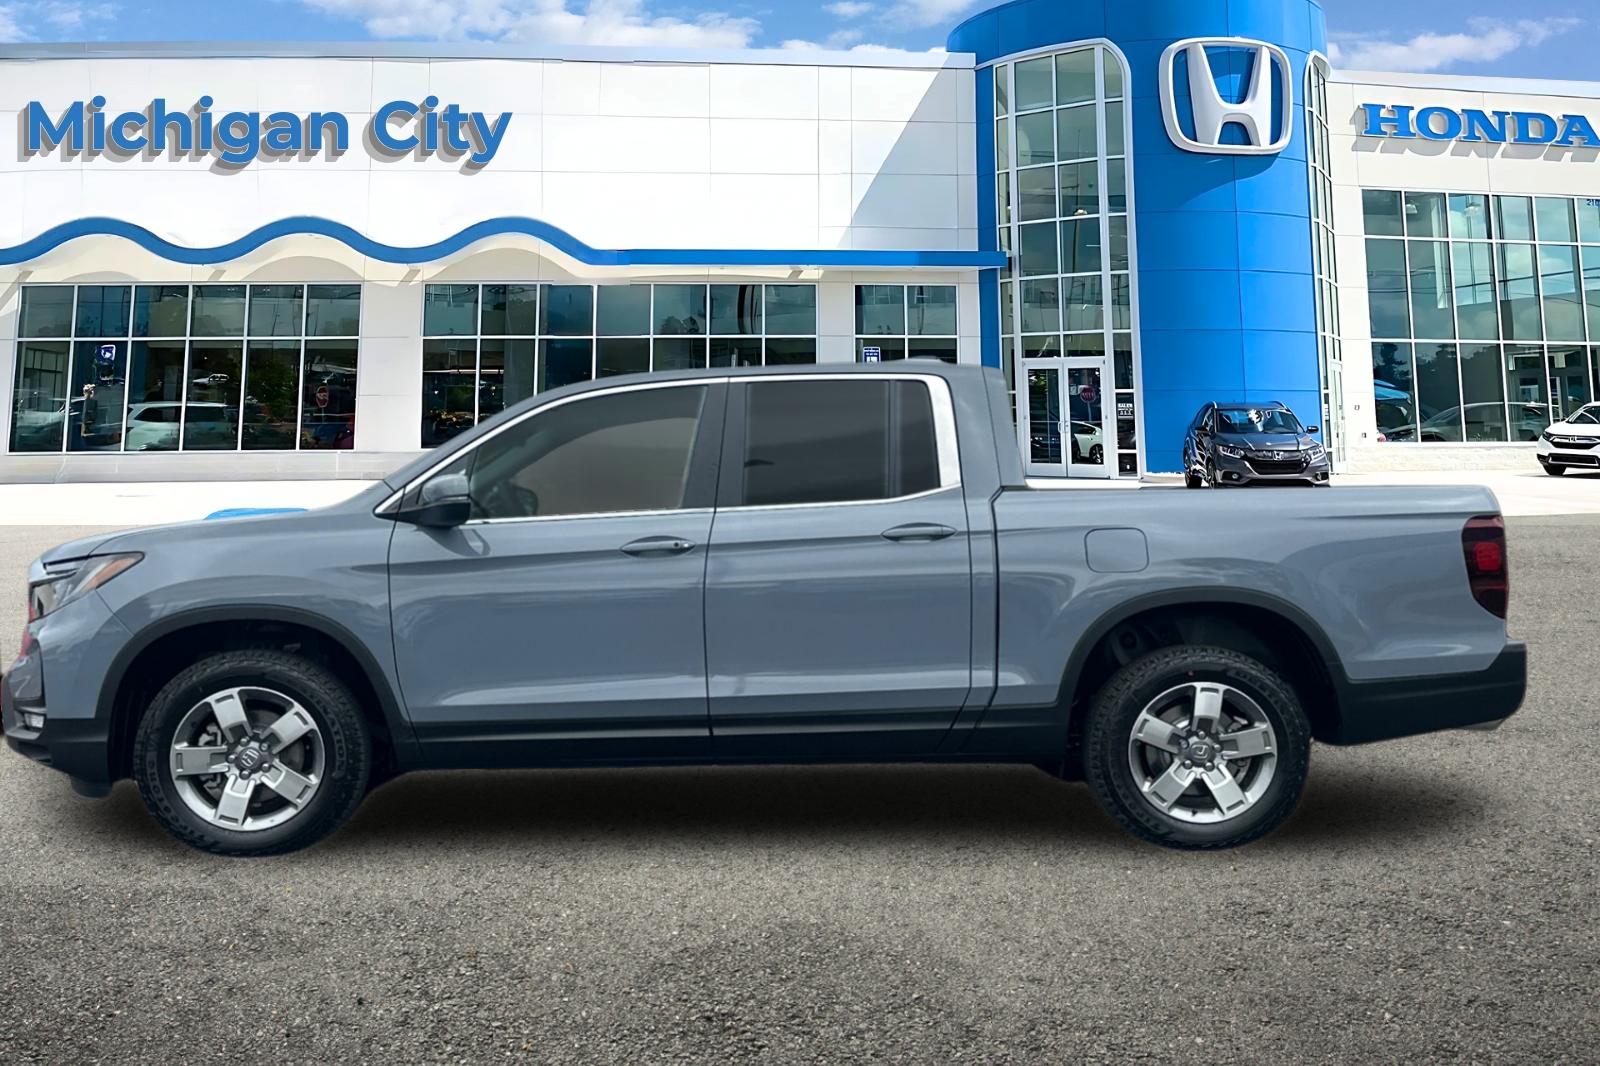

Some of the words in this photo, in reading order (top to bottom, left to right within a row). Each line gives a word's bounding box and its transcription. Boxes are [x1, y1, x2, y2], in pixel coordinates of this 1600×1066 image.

[28, 94, 349, 164] Michigan
[373, 94, 513, 164] City
[1361, 102, 1600, 148] HONDA
